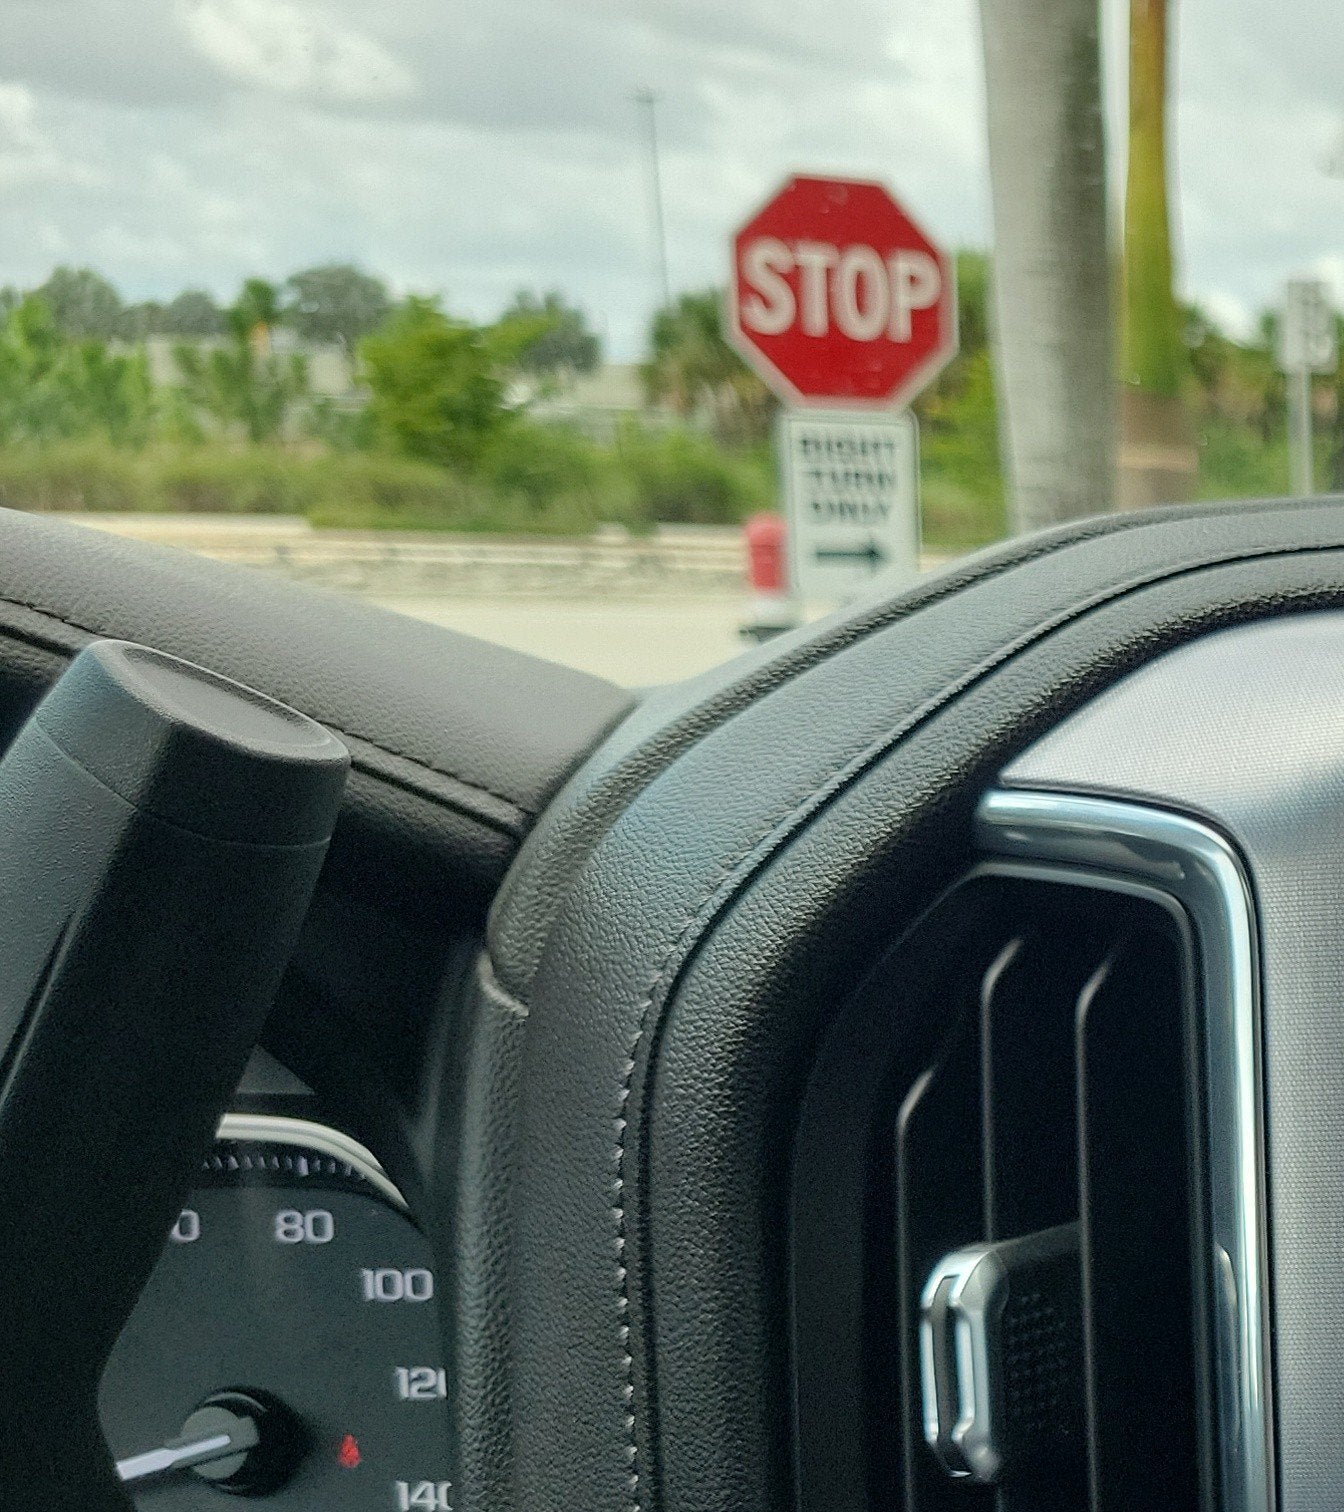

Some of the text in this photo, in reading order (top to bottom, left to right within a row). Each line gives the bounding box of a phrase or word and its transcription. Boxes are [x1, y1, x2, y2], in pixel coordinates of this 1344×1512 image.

[739, 236, 942, 343] STOP
[275, 1209, 335, 1245] 80
[361, 1267, 434, 1302] 100
[395, 1367, 447, 1400] 12
